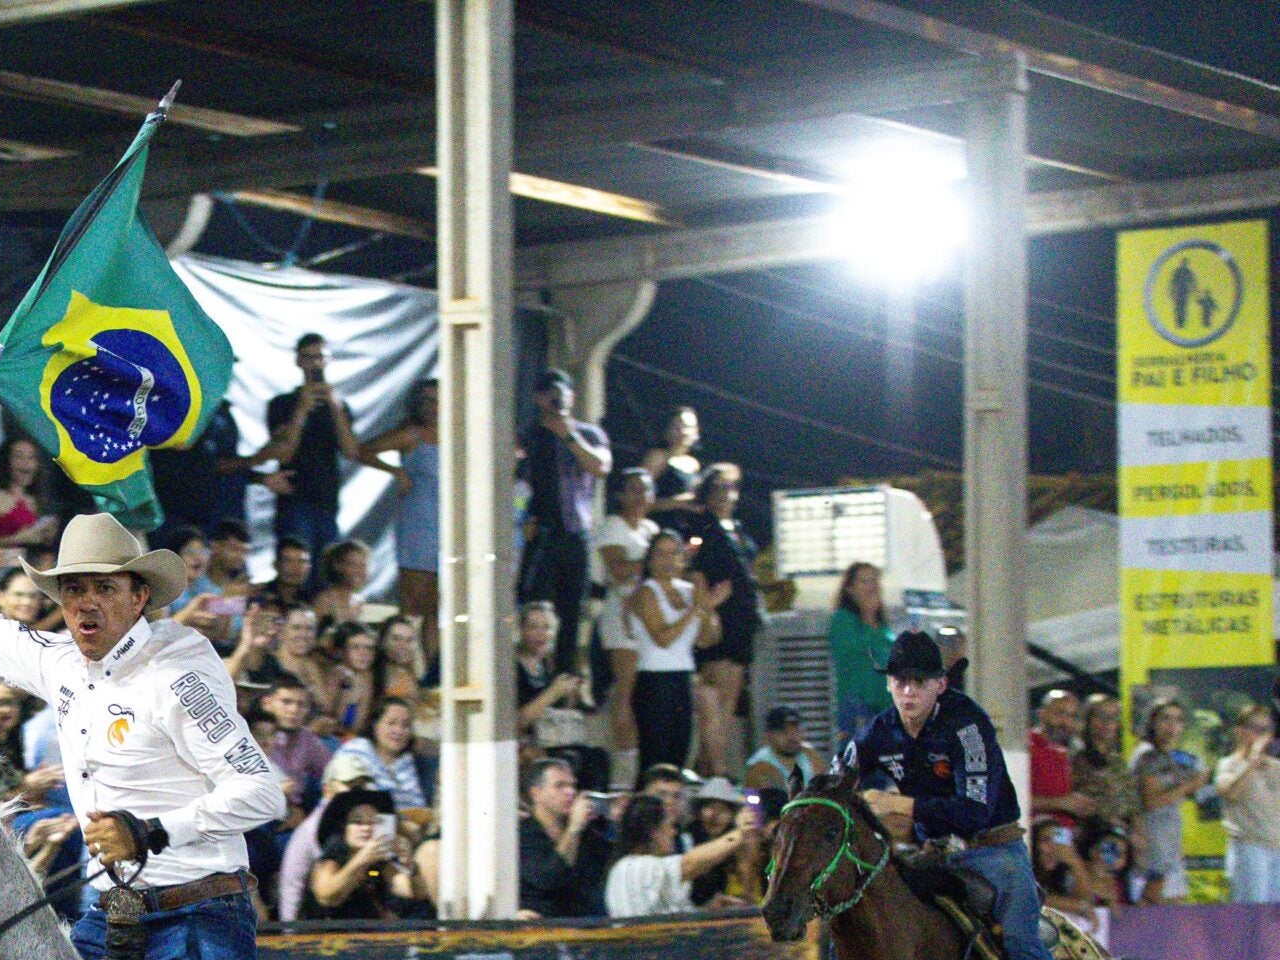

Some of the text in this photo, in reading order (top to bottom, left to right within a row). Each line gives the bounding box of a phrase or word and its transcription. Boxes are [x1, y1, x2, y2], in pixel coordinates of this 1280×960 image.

[1173, 365, 1186, 387] E
[1191, 358, 1258, 386] FILHO
[170, 671, 270, 775] RODEO WAY
